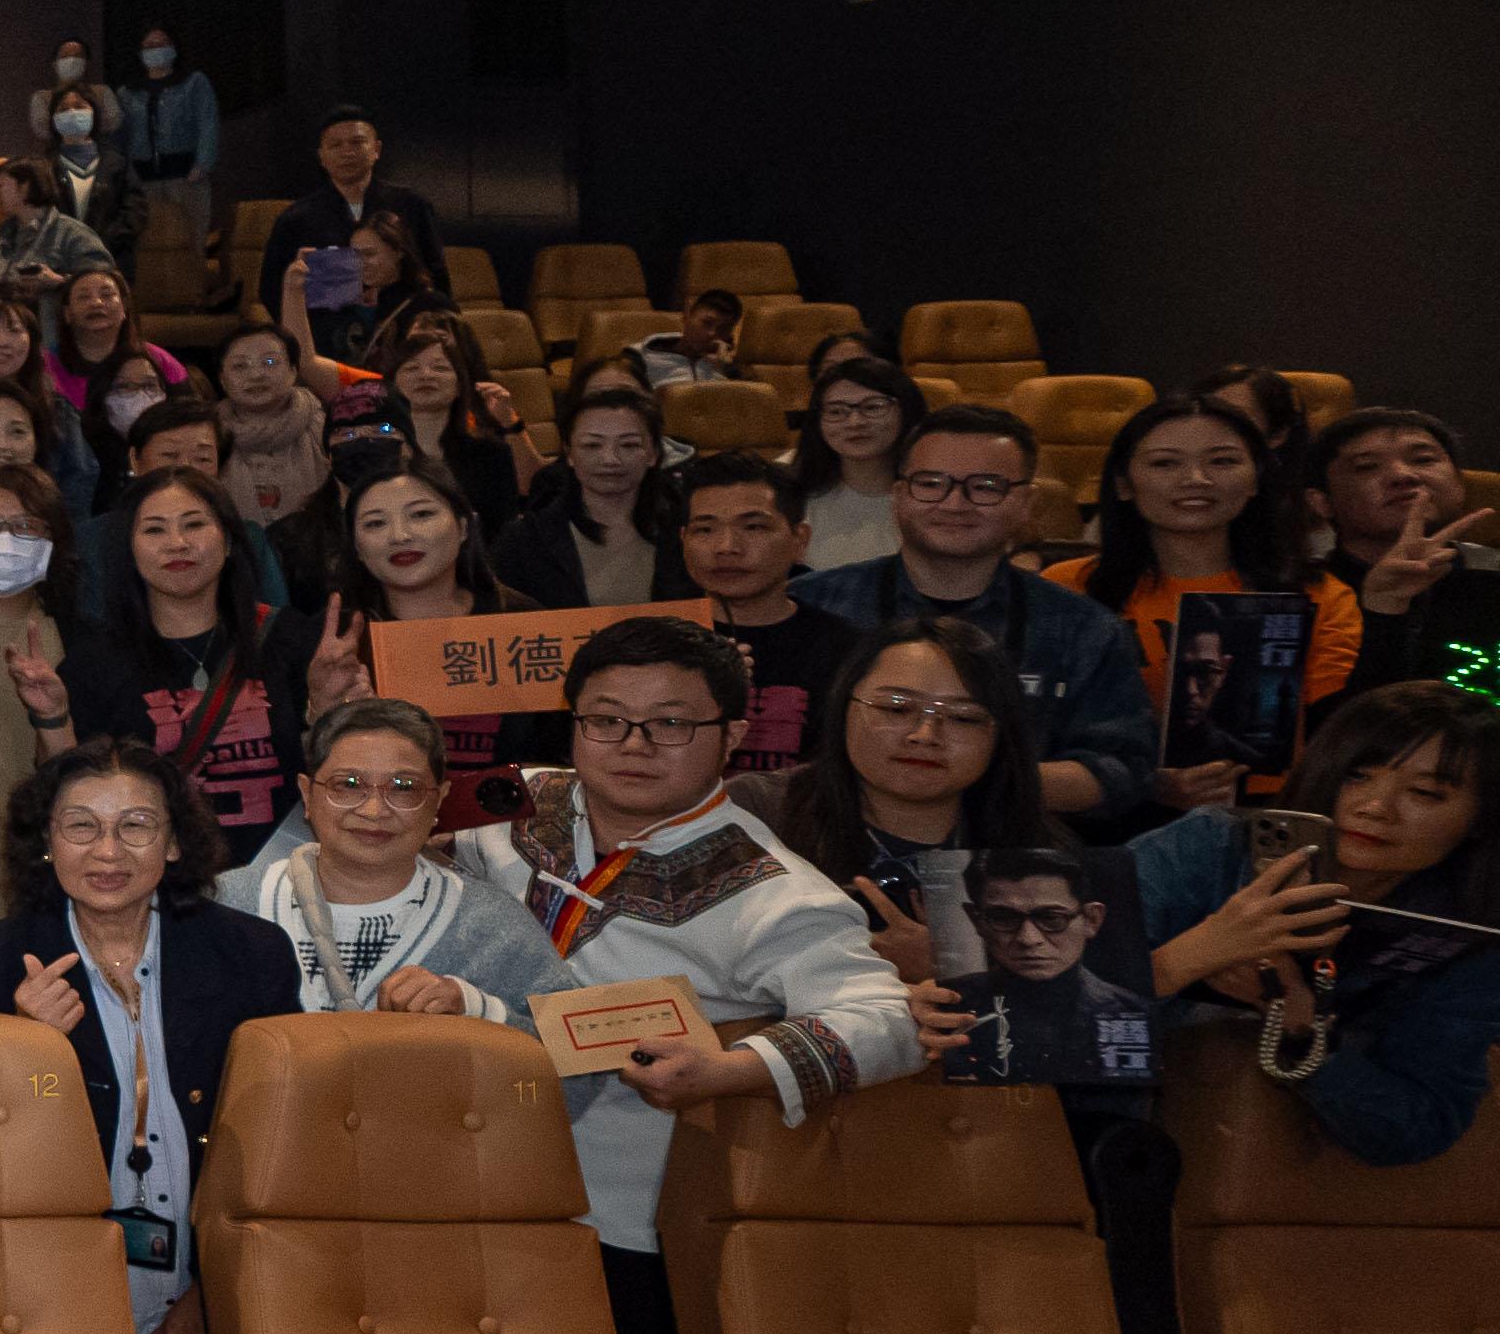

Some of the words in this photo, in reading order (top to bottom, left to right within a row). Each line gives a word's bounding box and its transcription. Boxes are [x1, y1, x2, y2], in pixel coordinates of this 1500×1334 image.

[442, 631, 597, 688] 劉德
[29, 1073, 61, 1097] 12
[513, 1080, 537, 1104] 11
